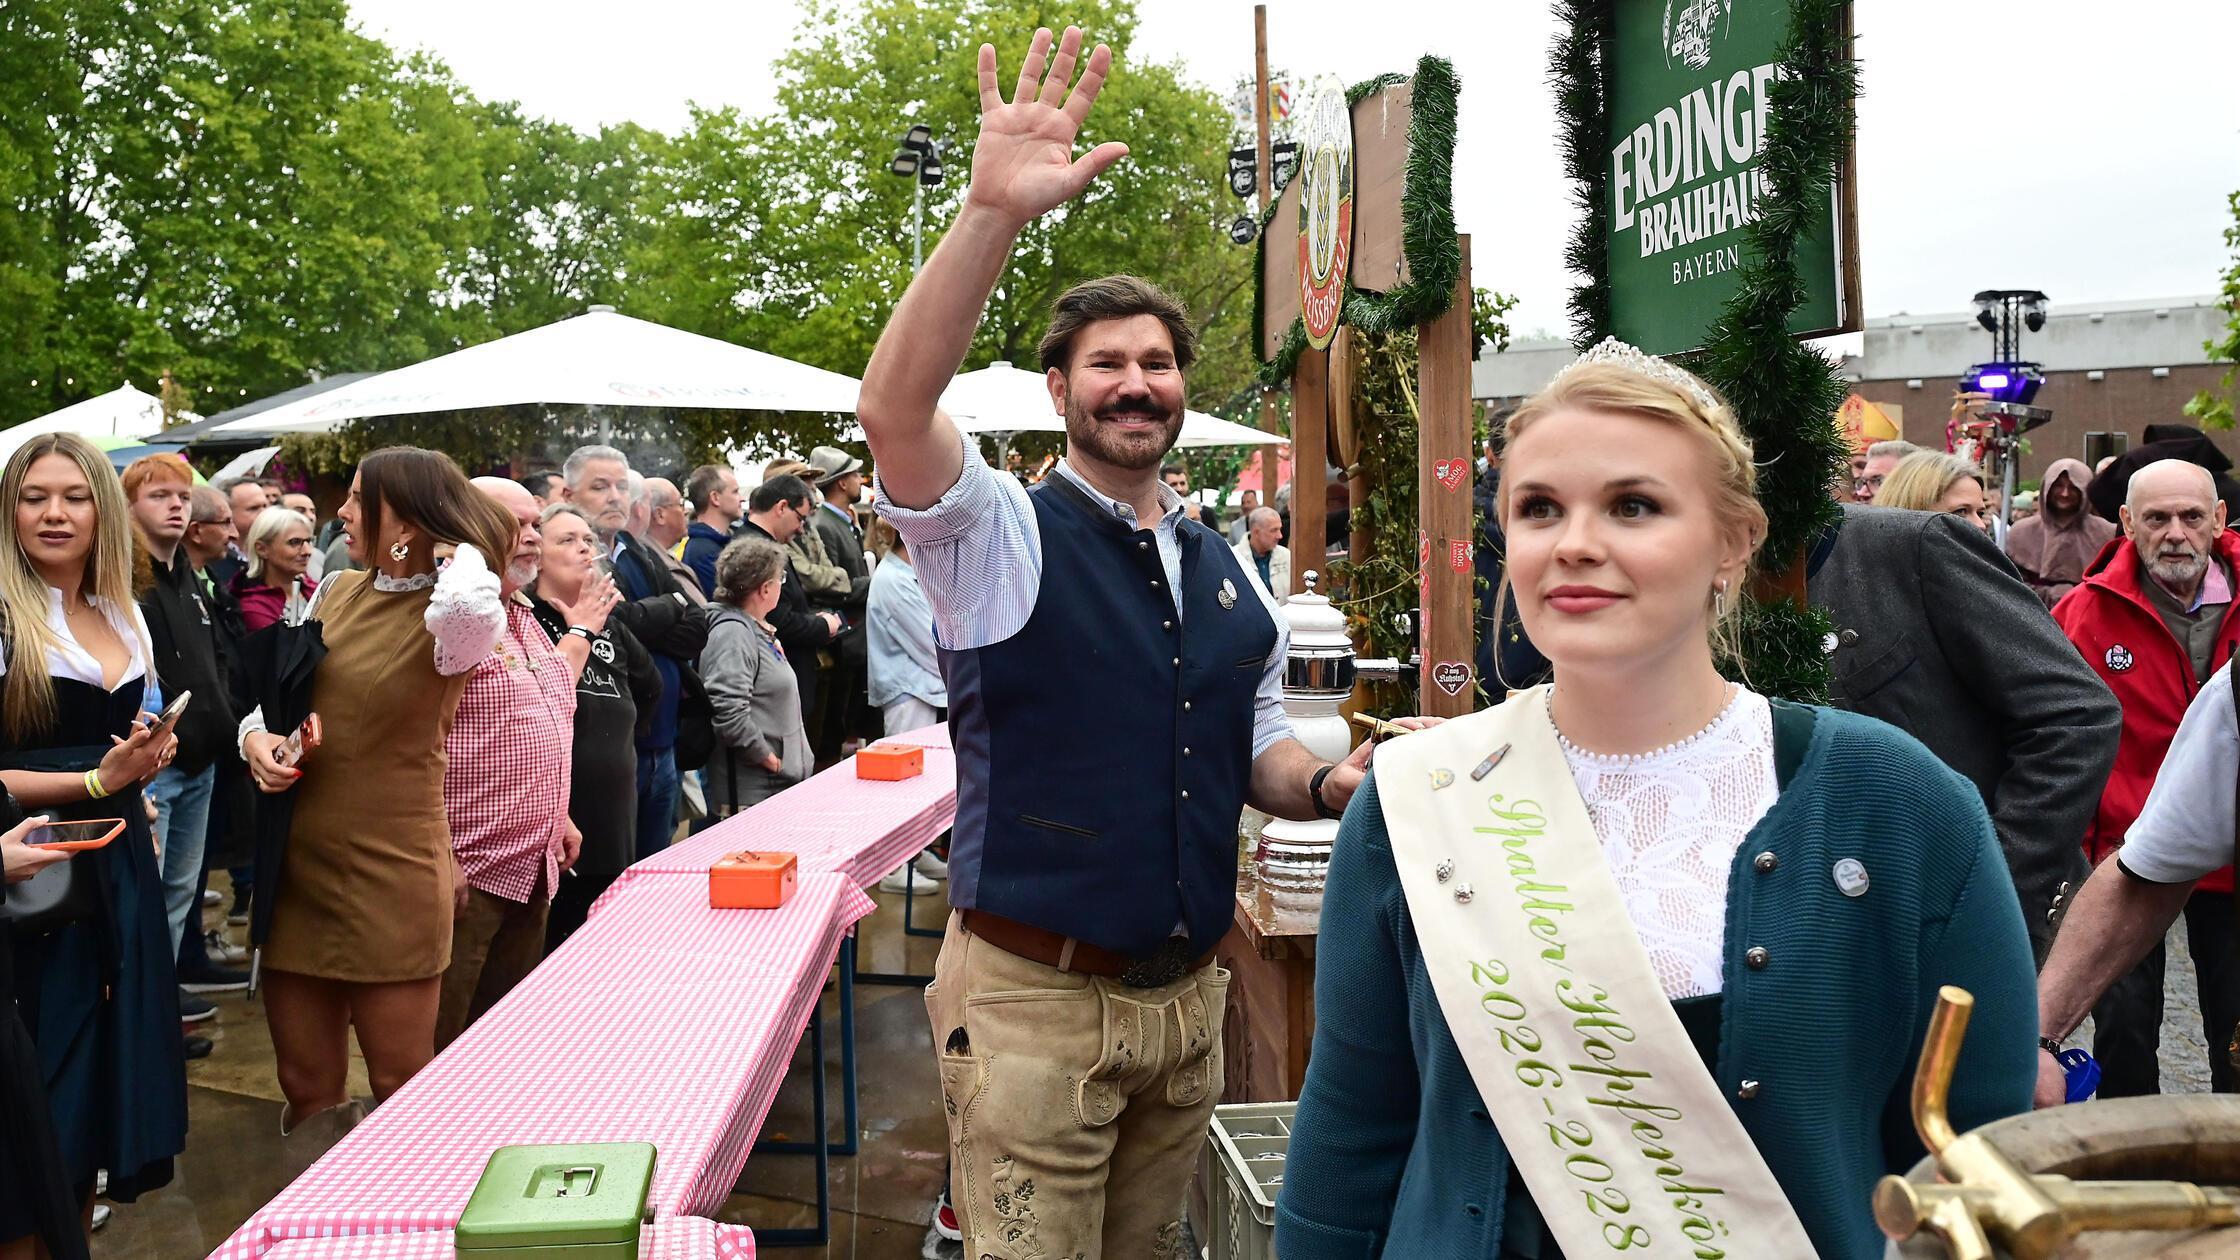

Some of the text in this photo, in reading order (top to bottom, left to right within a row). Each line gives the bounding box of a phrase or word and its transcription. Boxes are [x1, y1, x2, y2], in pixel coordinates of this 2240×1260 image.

[1611, 62, 1802, 233] ERDINGE
[1672, 244, 1739, 285] BAYERN
[1473, 793, 1574, 976] Spalter
[1469, 959, 1651, 1251] 2026-2028
